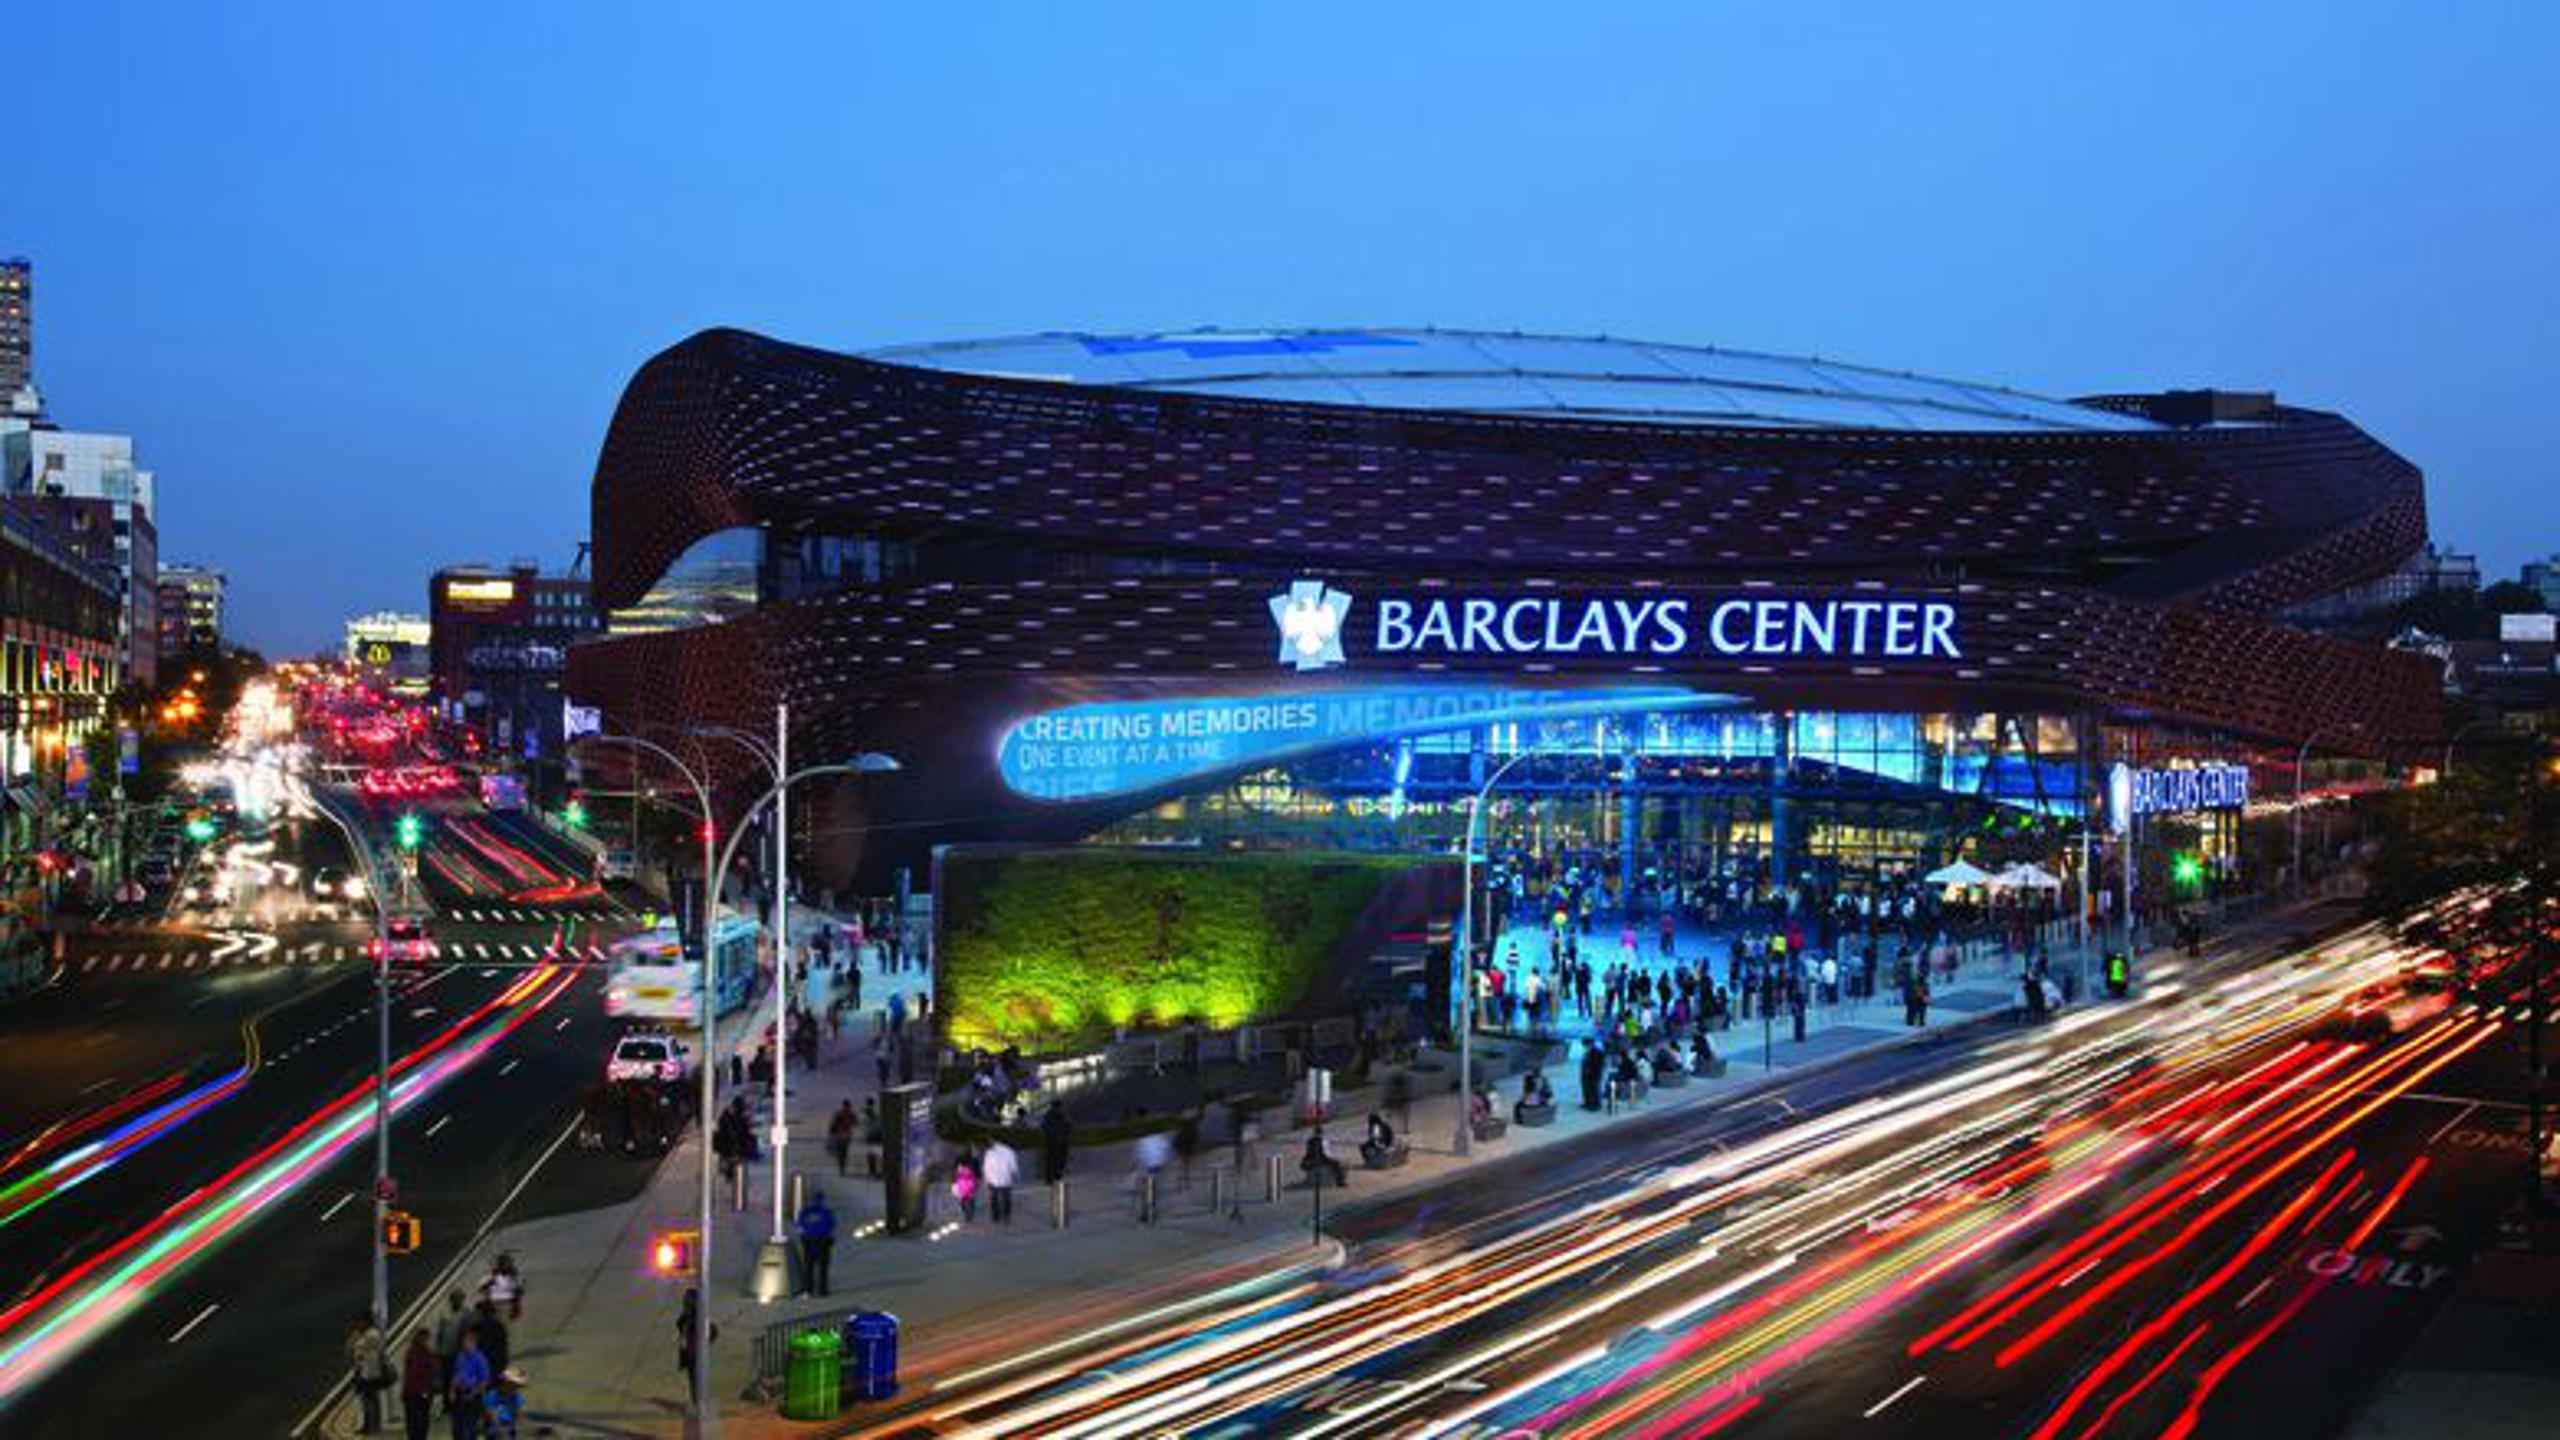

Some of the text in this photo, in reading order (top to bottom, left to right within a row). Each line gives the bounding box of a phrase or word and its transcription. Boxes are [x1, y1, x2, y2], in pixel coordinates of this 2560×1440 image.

[1376, 599, 1961, 658] BARCLAYS CENTER
[1019, 702, 1317, 741] CREATING MEMORIES
[1019, 745, 1056, 771] ONE
[1063, 744, 1118, 768] EVENT
[1124, 745, 1148, 764] AT
[1154, 745, 1170, 763] A
[2307, 1251, 2448, 1289] ONLY
